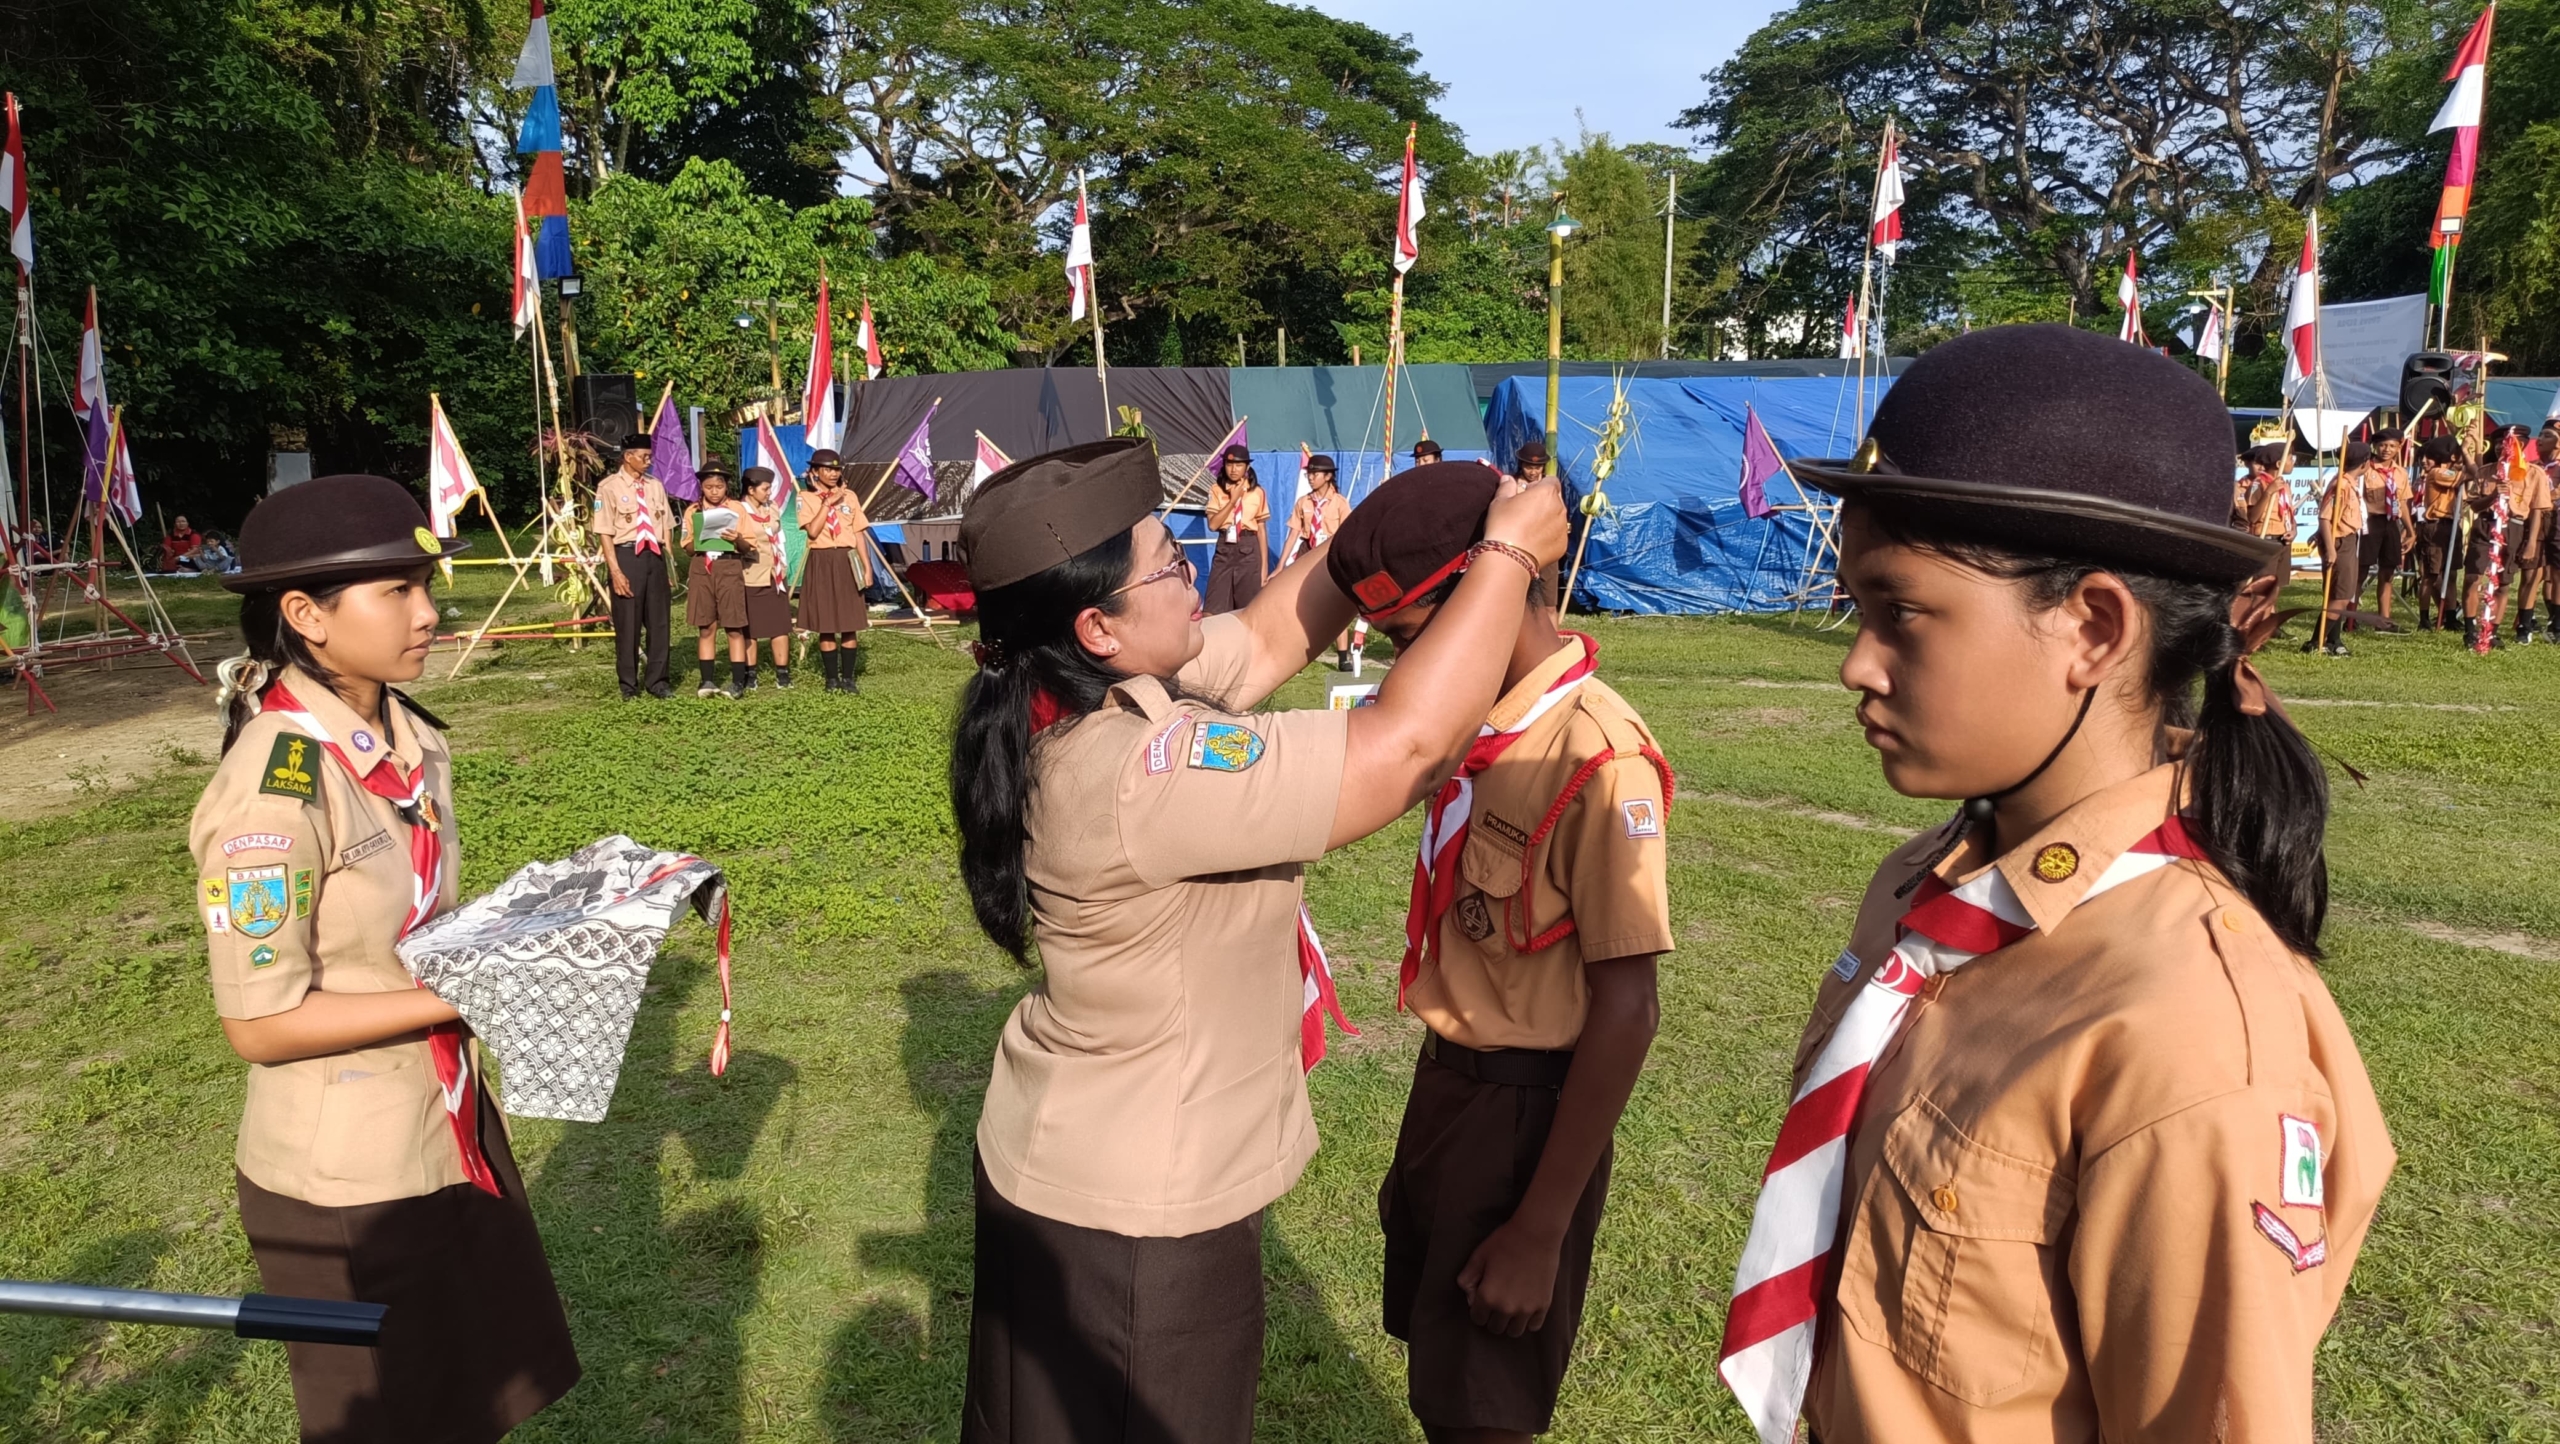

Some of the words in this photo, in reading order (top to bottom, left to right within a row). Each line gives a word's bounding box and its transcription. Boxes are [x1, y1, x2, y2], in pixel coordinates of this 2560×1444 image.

[1193, 728, 1206, 760] BALI
[266, 778, 312, 795] LAKSANA
[1486, 815, 1526, 845] PRAMUKA
[227, 836, 287, 853] DENPASAR
[236, 870, 275, 881] BALI
